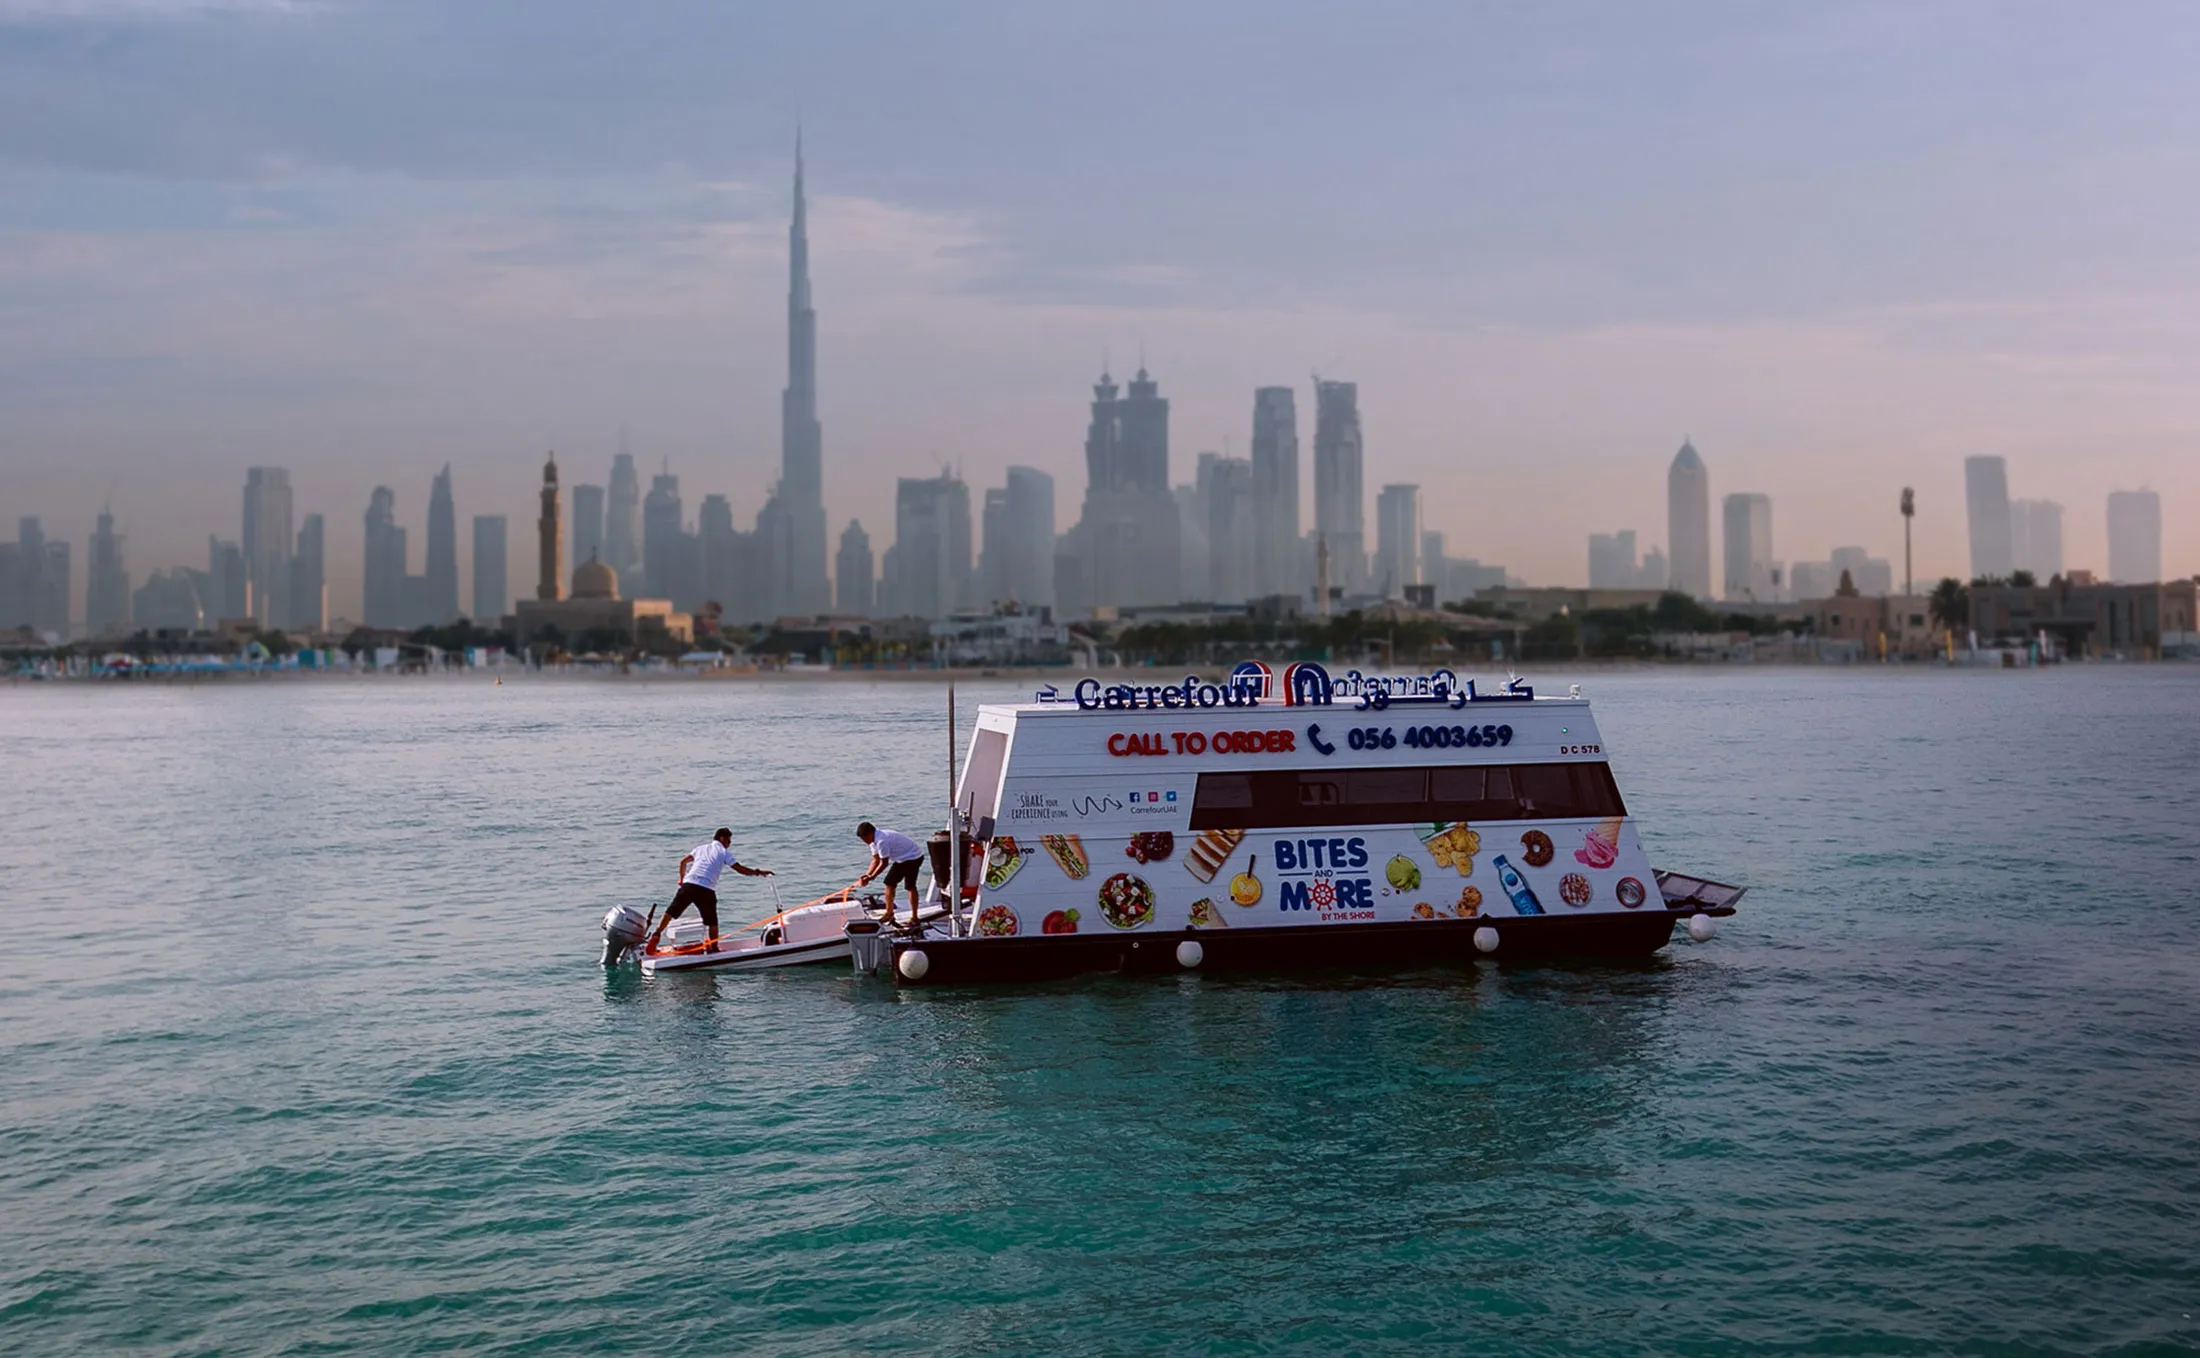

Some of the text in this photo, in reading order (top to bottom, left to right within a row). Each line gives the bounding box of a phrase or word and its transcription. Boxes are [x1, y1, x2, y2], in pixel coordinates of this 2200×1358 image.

[1075, 675, 1260, 710] Carrefour
[1354, 678, 1534, 711] كارفور
[1107, 730, 1296, 757] CALL TO ORDER
[1348, 724, 1514, 751] 056 4003659
[1581, 745, 1600, 755] 578
[1020, 794, 1044, 808] SHARE
[1130, 804, 1178, 815] CarrefourUAE
[1011, 808, 1050, 819] EXPERIENCE
[1274, 837, 1369, 870] BITES
[1314, 869, 1334, 878] AND
[1280, 878, 1375, 911] MORE
[1321, 911, 1376, 921] BY THE SHORE
